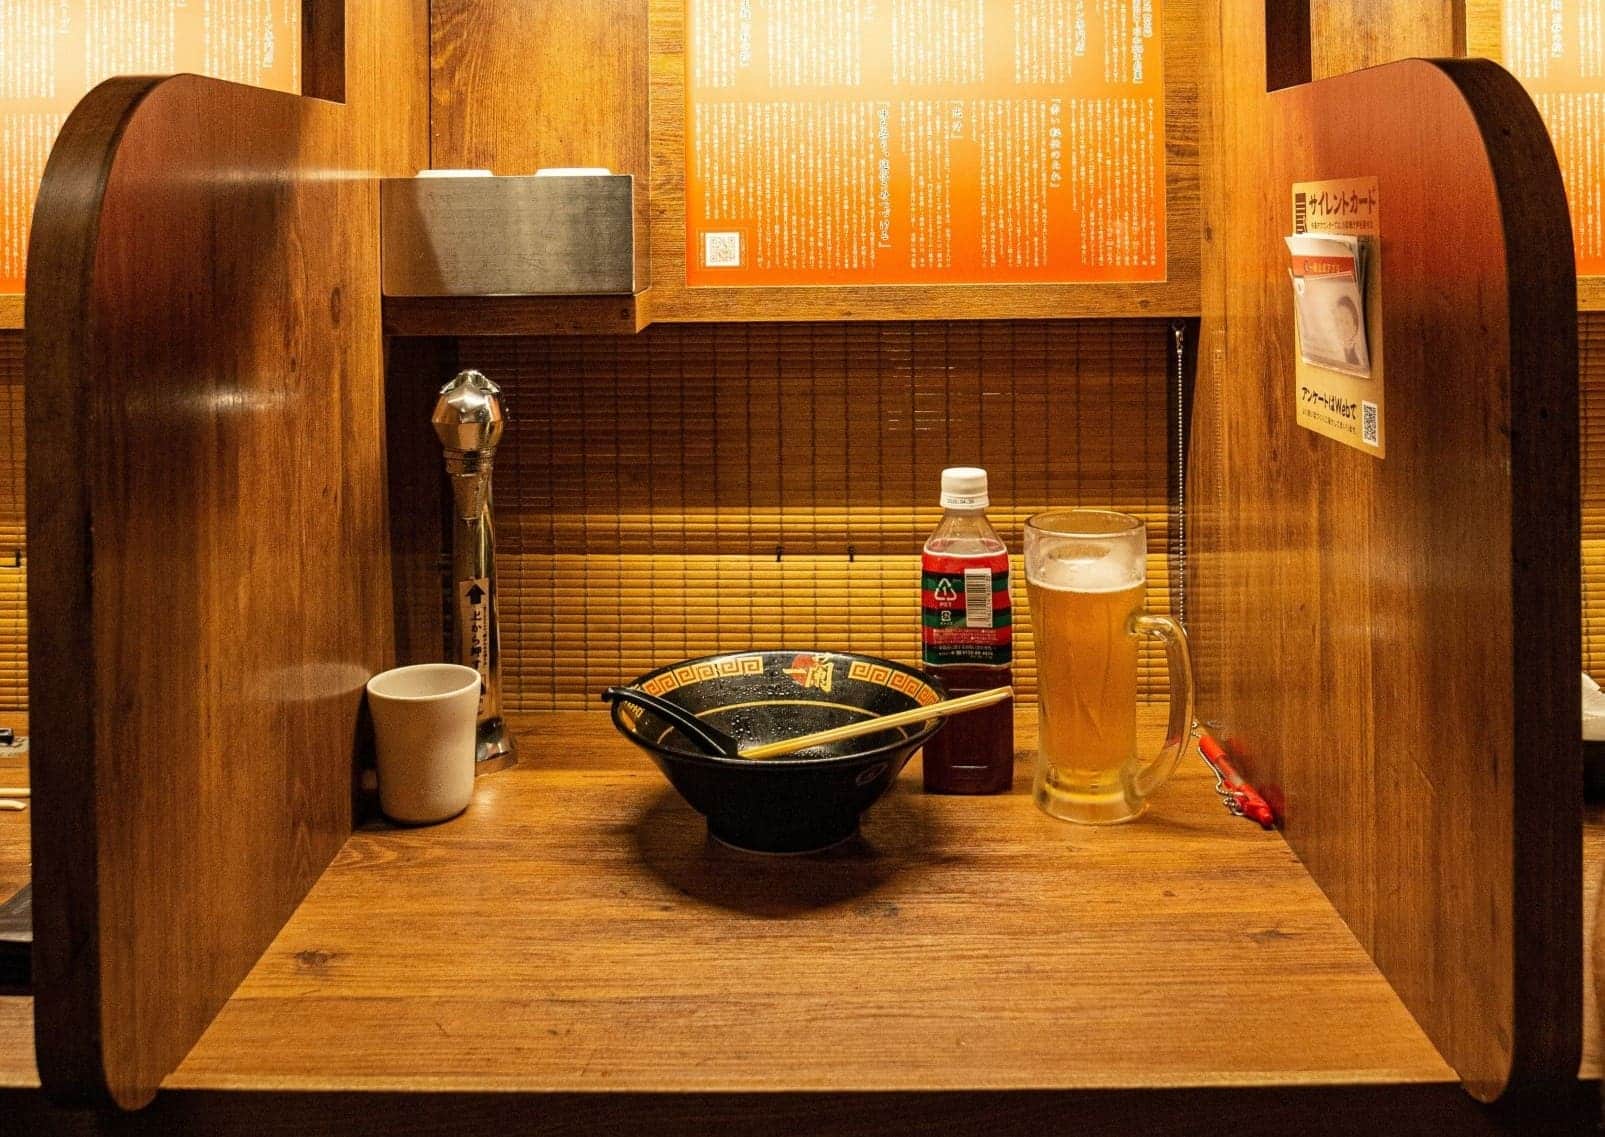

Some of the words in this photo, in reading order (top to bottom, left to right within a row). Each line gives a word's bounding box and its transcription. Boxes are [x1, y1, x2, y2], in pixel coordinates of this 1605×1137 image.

[1308, 186, 1377, 216] サイレントカード
[1301, 386, 1358, 421] アンケートはWebで
